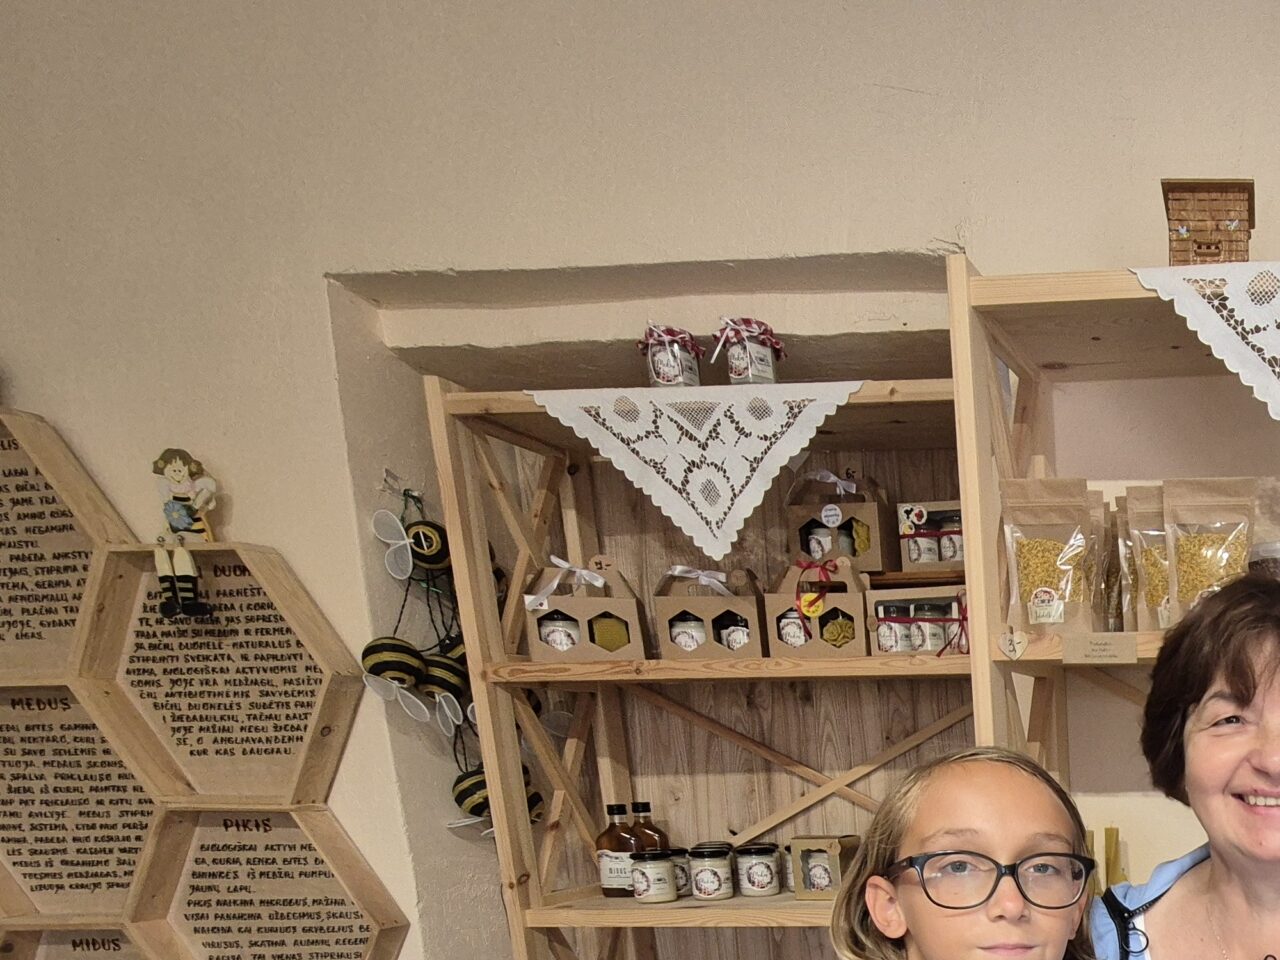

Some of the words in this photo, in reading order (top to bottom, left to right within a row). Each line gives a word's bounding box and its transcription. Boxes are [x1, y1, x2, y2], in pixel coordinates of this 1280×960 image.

[10, 697, 72, 711] MEDUS
[222, 817, 273, 834] PIKIS
[71, 937, 122, 952] MIDUS
